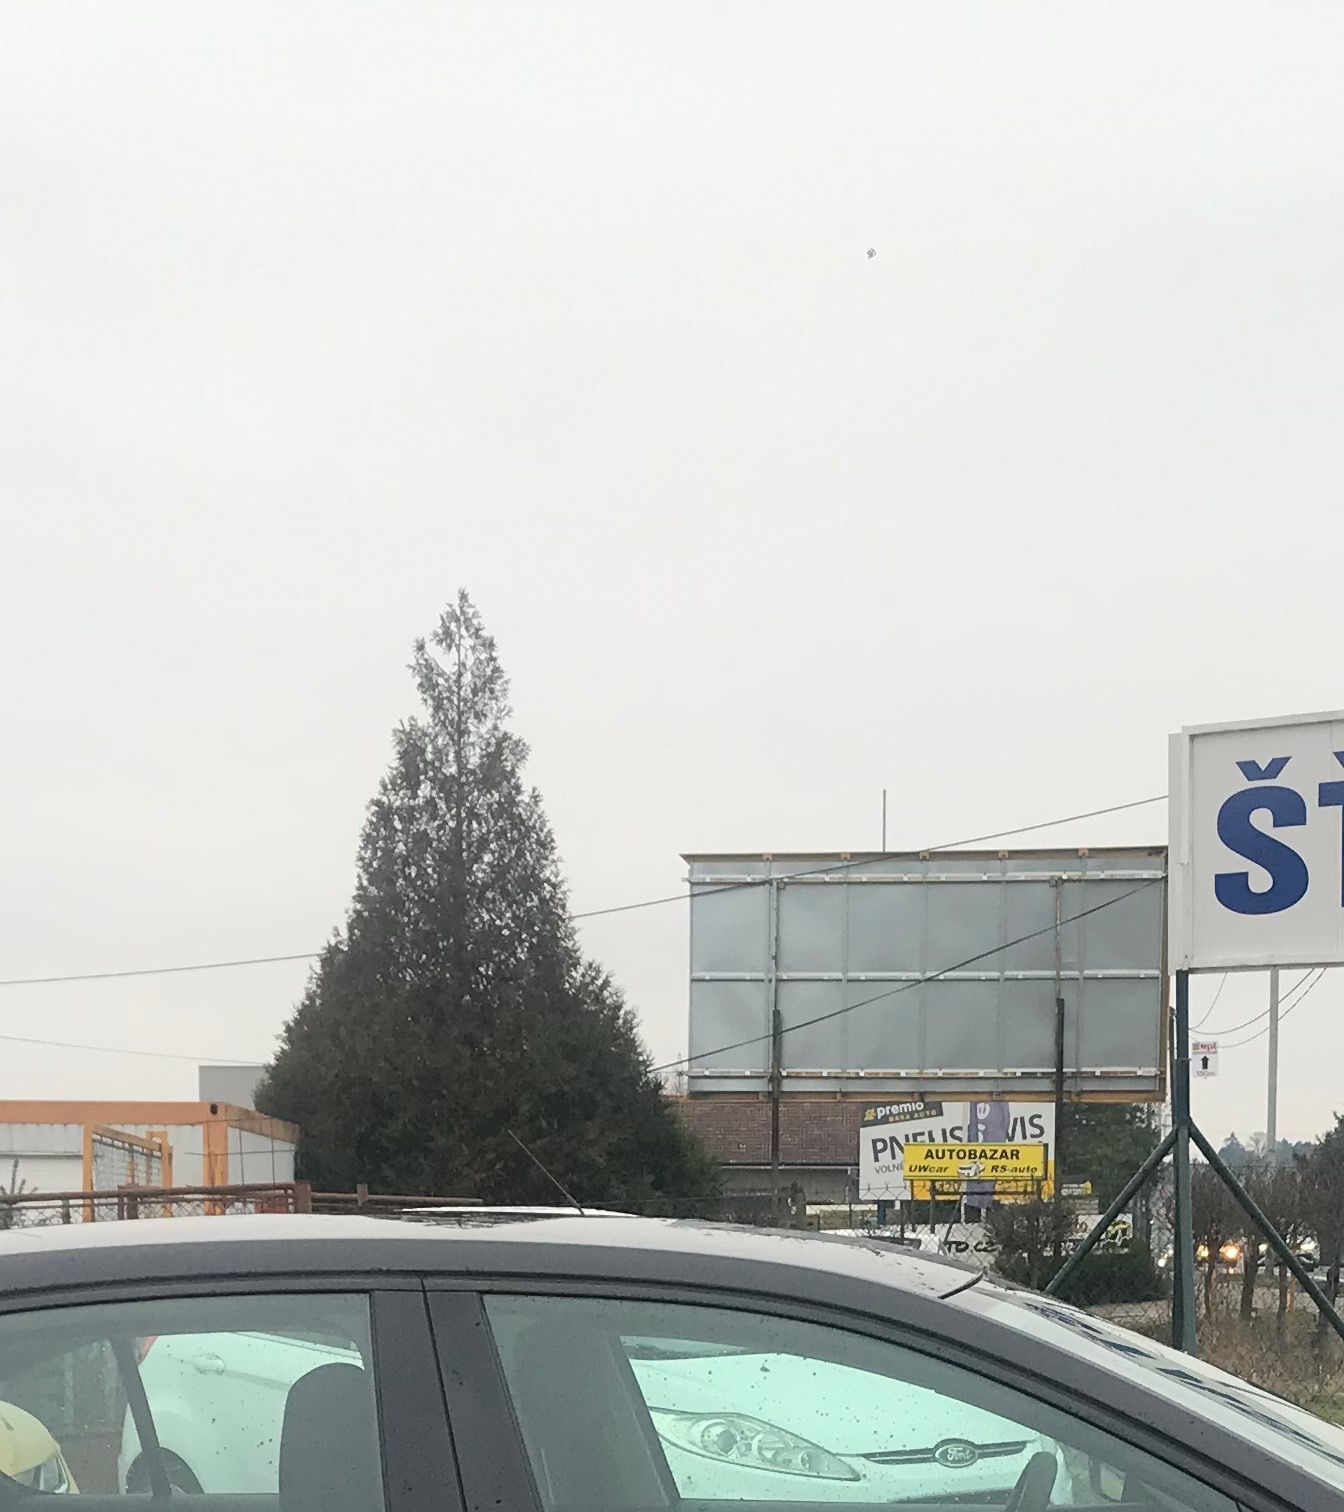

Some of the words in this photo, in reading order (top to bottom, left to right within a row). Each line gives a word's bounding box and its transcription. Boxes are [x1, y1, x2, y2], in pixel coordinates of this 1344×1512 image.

[877, 1101, 924, 1119] premio
[924, 1148, 1020, 1161] AUTOBAZAR
[908, 1164, 949, 1174] UWcar
[990, 1164, 1038, 1175] RS-auto
